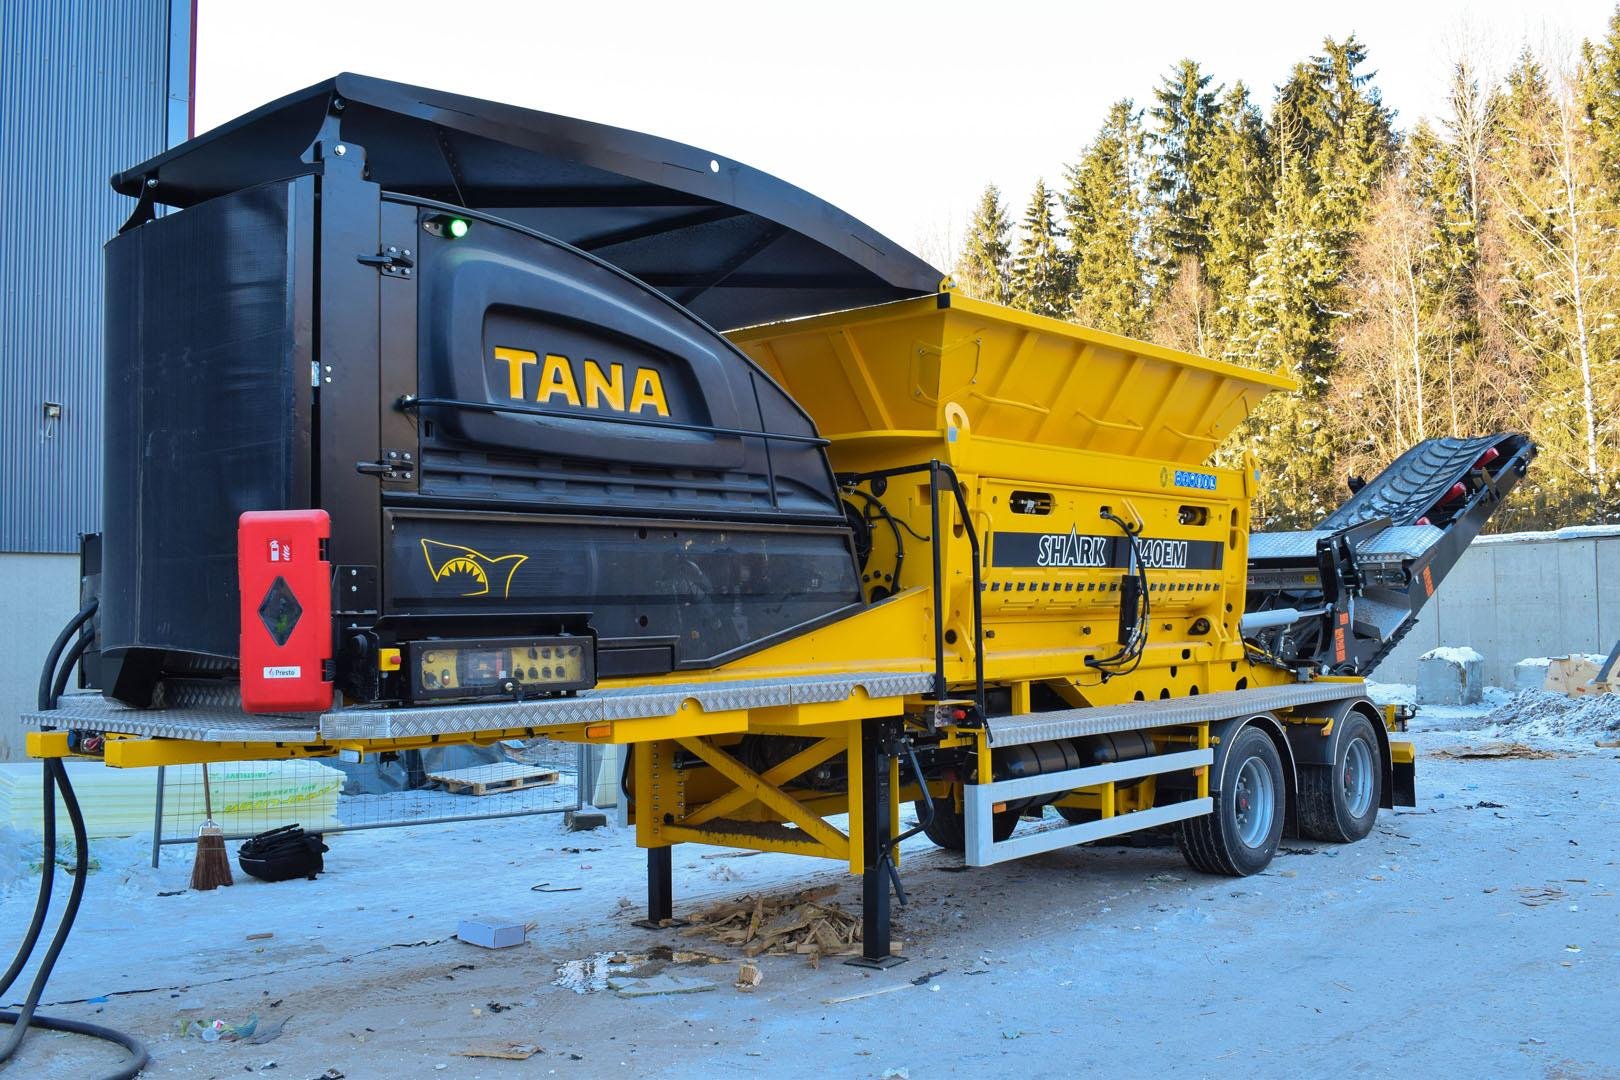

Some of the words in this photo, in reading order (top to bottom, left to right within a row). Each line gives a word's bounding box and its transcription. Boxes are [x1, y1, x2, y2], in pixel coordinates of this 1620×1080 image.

[494, 346, 671, 417] TANA
[1037, 522, 1106, 567] SHARK
[1135, 539, 1188, 568] 40EM
